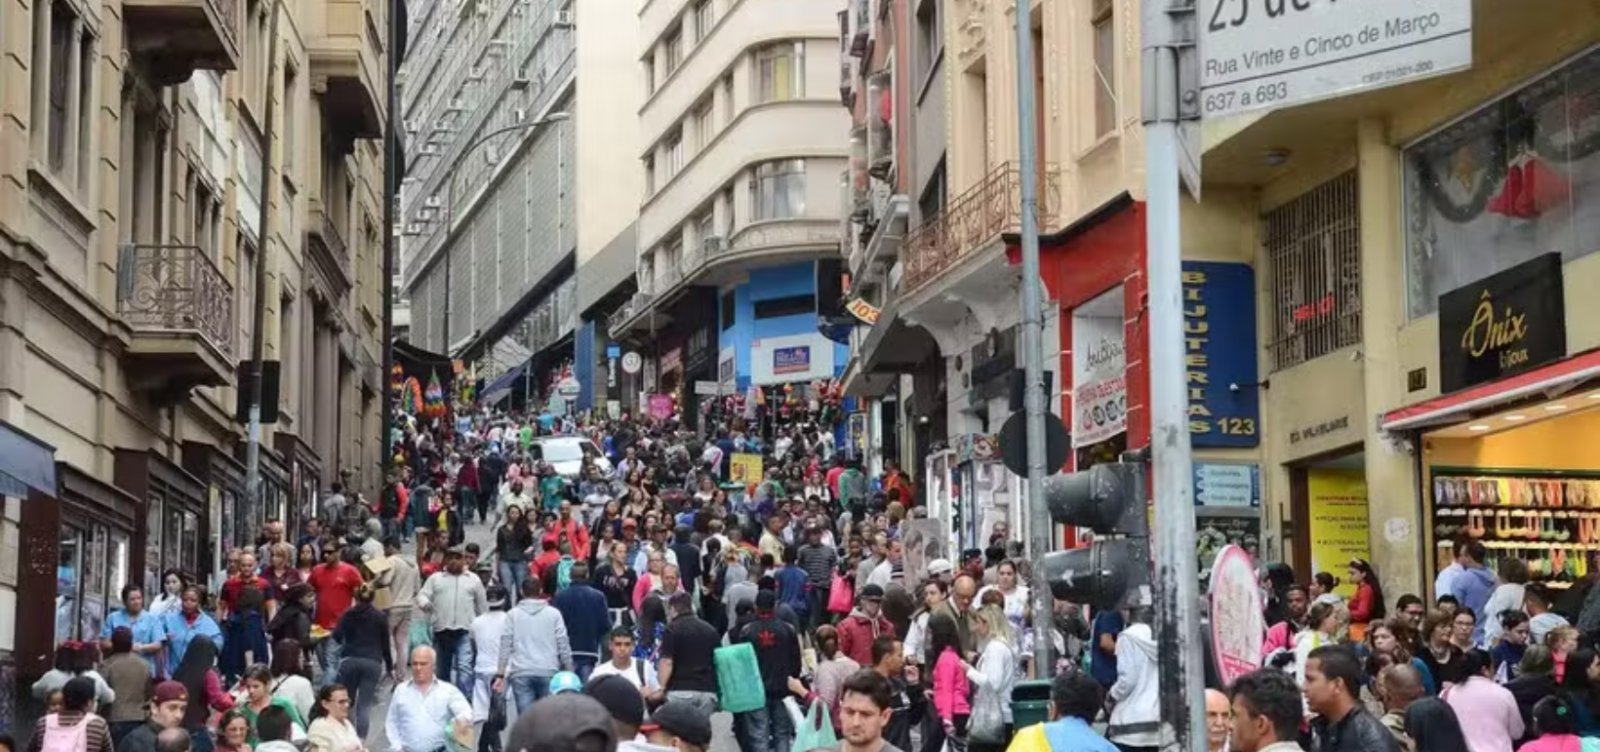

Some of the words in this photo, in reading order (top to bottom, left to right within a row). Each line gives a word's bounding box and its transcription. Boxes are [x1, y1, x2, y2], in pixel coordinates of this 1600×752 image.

[1205, 59, 1238, 77] Rua
[1243, 48, 1285, 69] Vinte
[1289, 46, 1300, 60] e
[1304, 33, 1354, 57] Cinco
[1358, 24, 1379, 45] de
[1385, 11, 1440, 38] Março
[1205, 91, 1236, 112] 637
[1241, 91, 1252, 106] a
[1256, 81, 1288, 103] 693
[1182, 271, 1212, 433] BIJUTERIAS
[1461, 289, 1528, 357] Ônix
[1217, 417, 1255, 434] 123
